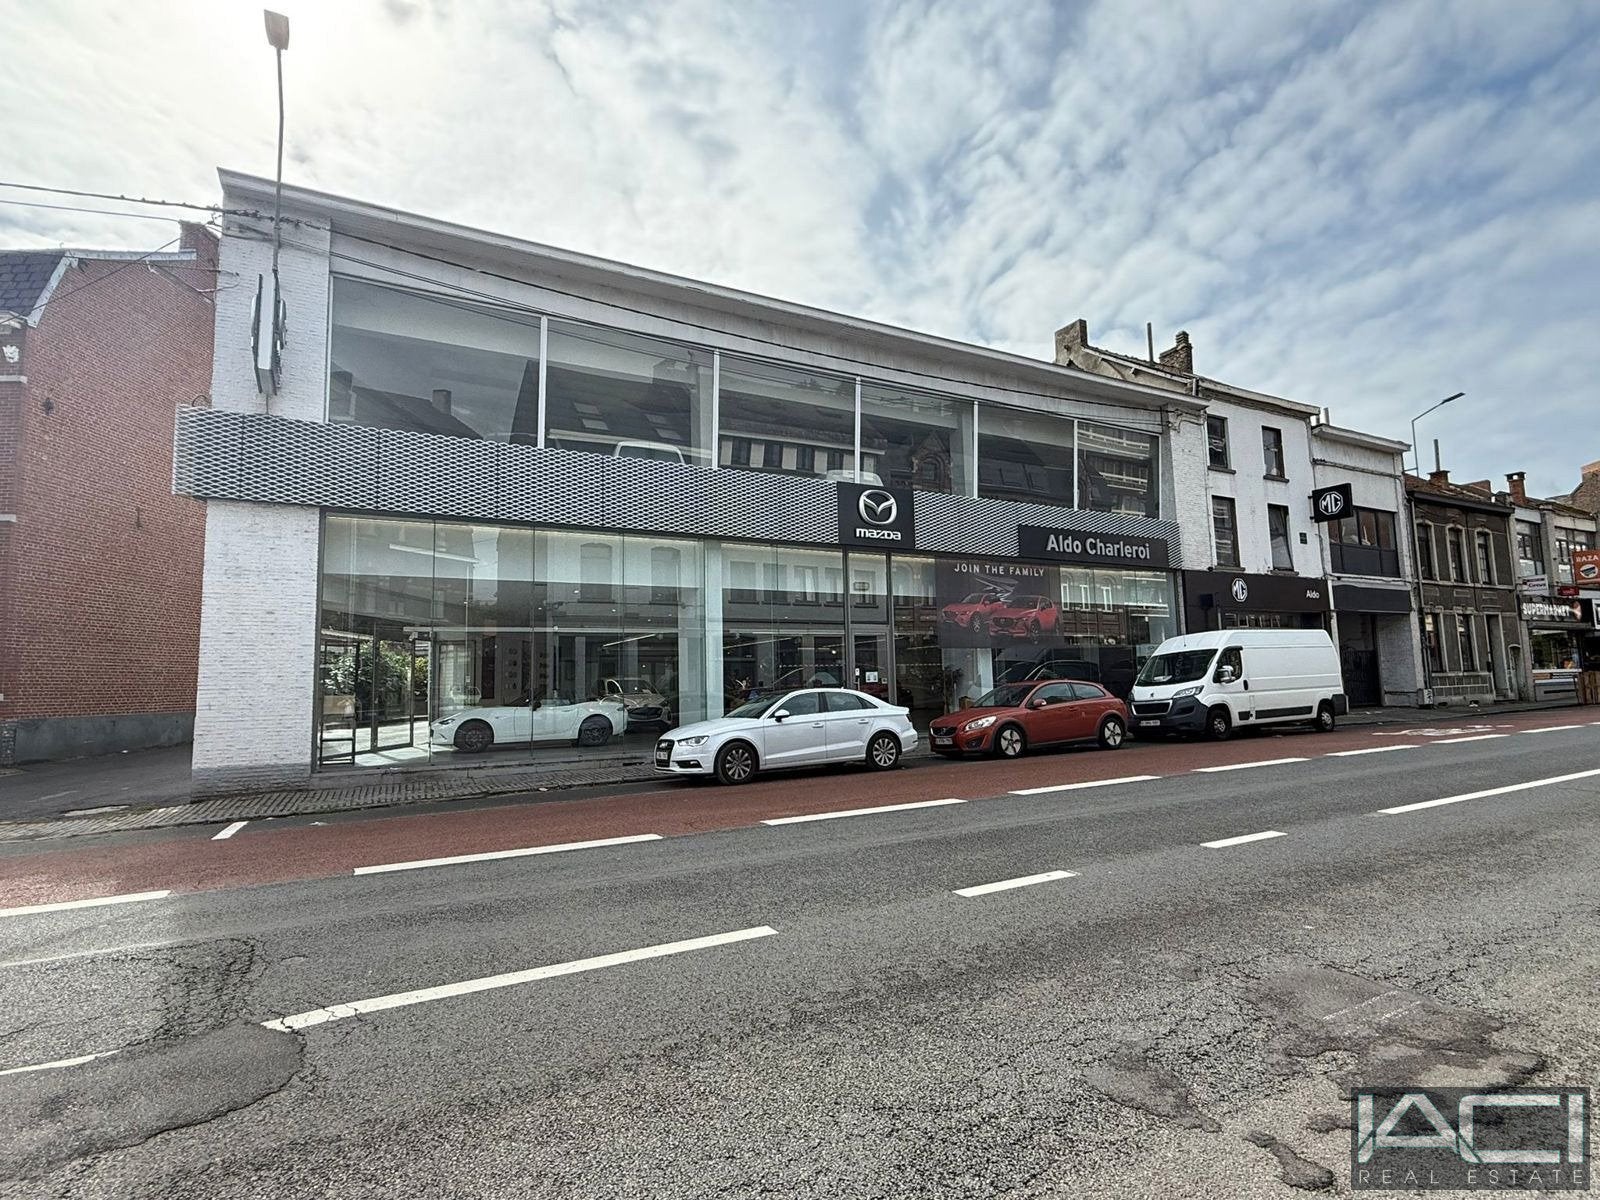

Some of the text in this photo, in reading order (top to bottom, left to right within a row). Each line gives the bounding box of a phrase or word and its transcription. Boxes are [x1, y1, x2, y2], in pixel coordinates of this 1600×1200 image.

[1321, 493, 1341, 513] MG
[855, 528, 902, 540] mazda
[1046, 534, 1150, 559] Aldo Charleroi
[954, 563, 1045, 577] JOIN THE FAMILY
[1233, 579, 1247, 600] MG
[1306, 590, 1320, 599] Aldo
[1522, 602, 1570, 617] SUPERMARKET
